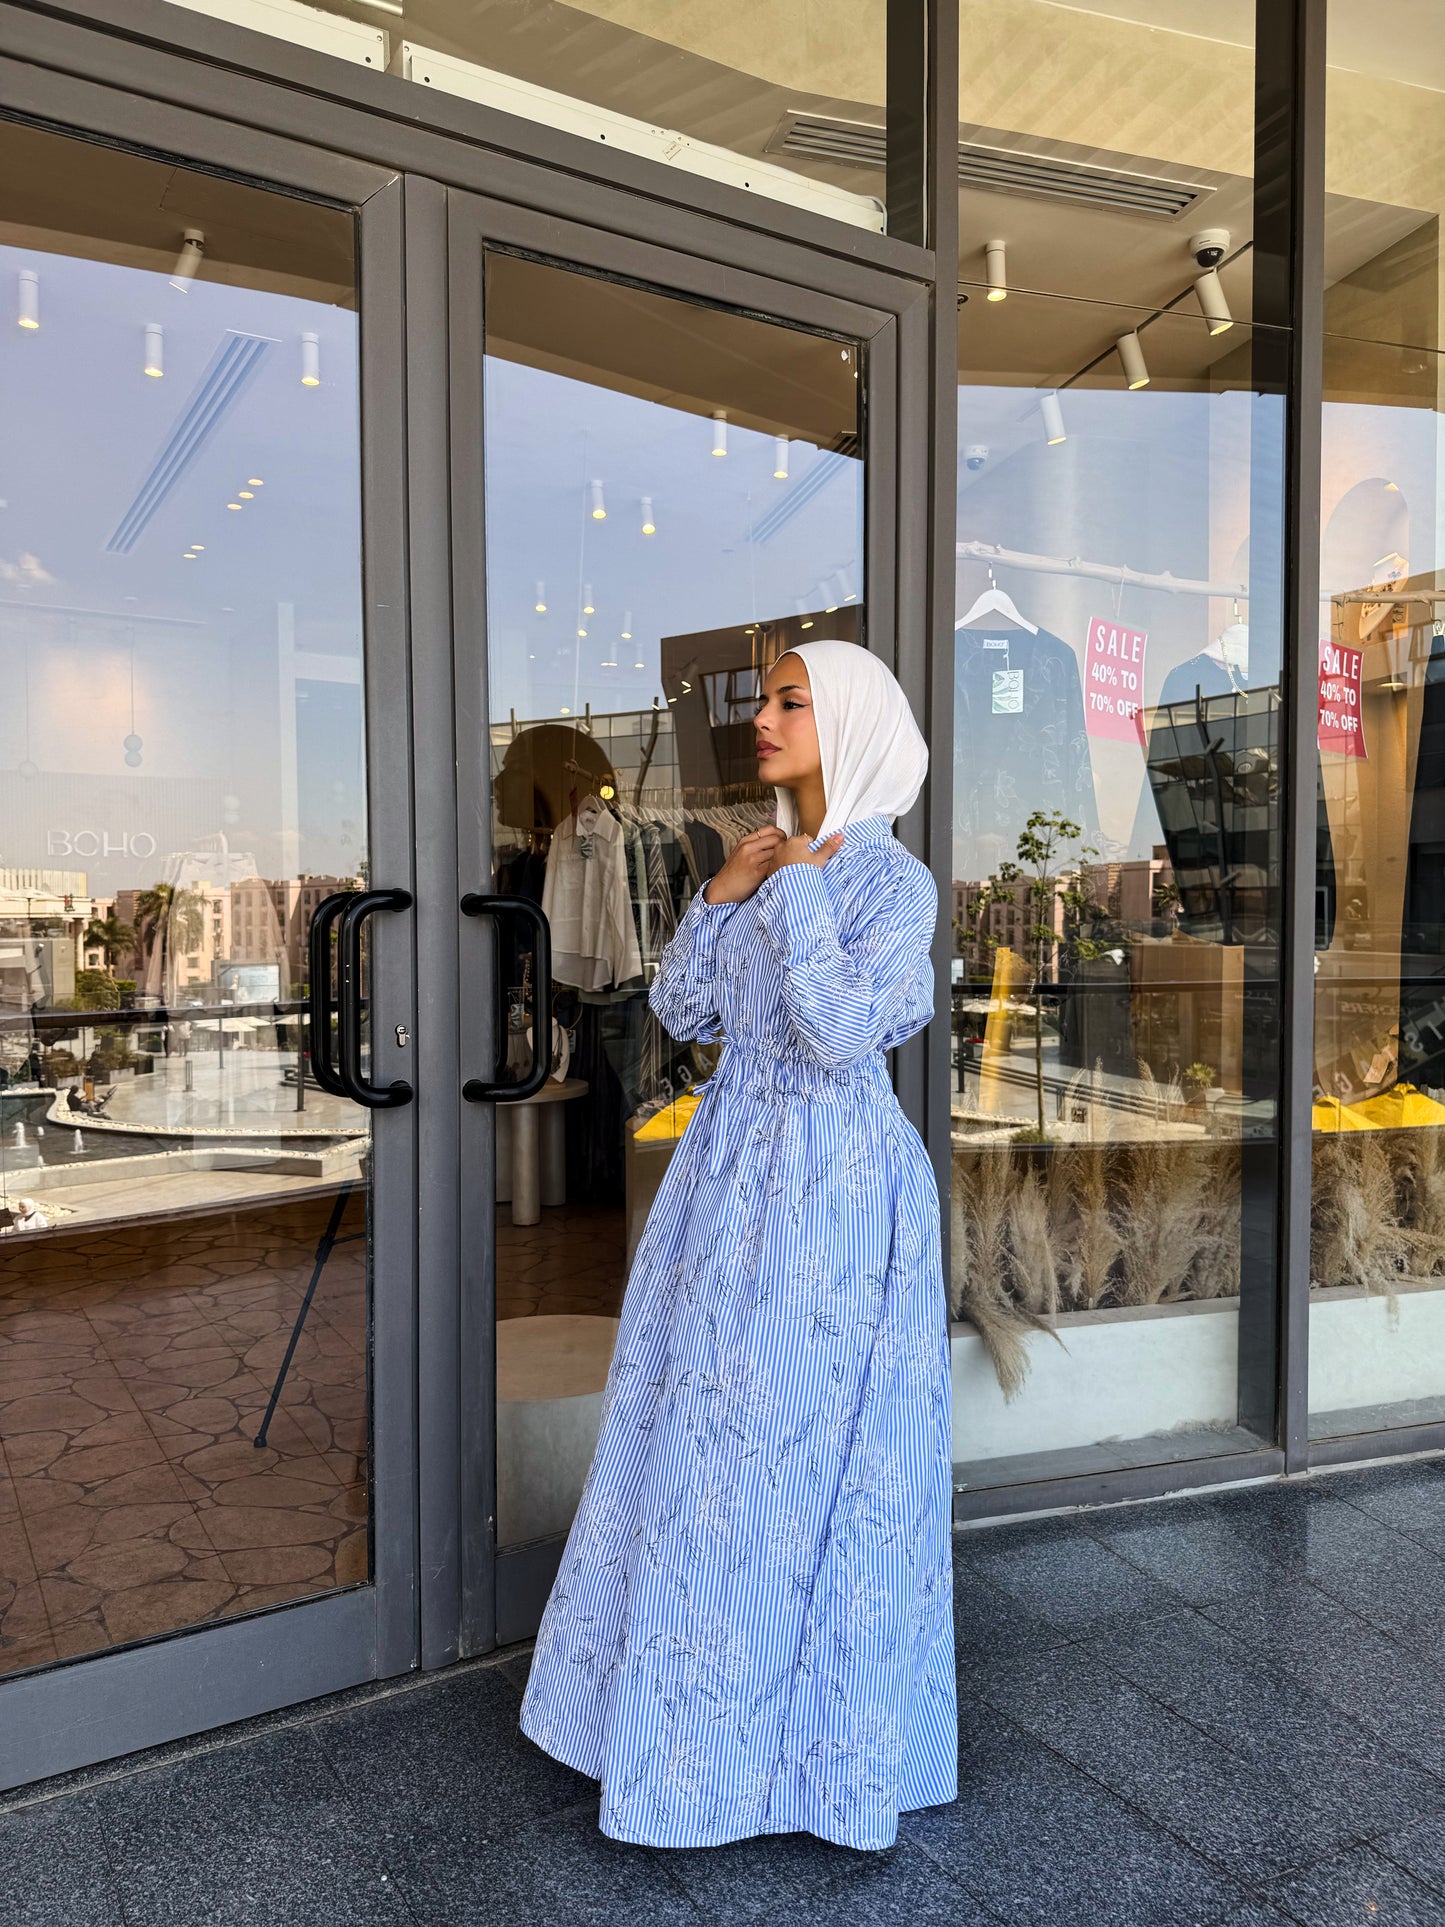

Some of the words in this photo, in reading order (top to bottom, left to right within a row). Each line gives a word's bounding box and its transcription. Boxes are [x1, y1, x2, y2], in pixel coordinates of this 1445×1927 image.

[1095, 624, 1142, 663] SALE
[1091, 661, 1118, 686] 40%
[1120, 669, 1138, 692] TO
[1322, 645, 1360, 681] SALE
[1089, 691, 1114, 714] 70%
[1116, 698, 1139, 719] OFF
[1320, 680, 1341, 703] 40%
[1343, 686, 1357, 707] TO
[1319, 708, 1340, 729] 70%
[1340, 713, 1359, 733] OFF
[47, 830, 157, 859] BOHO
